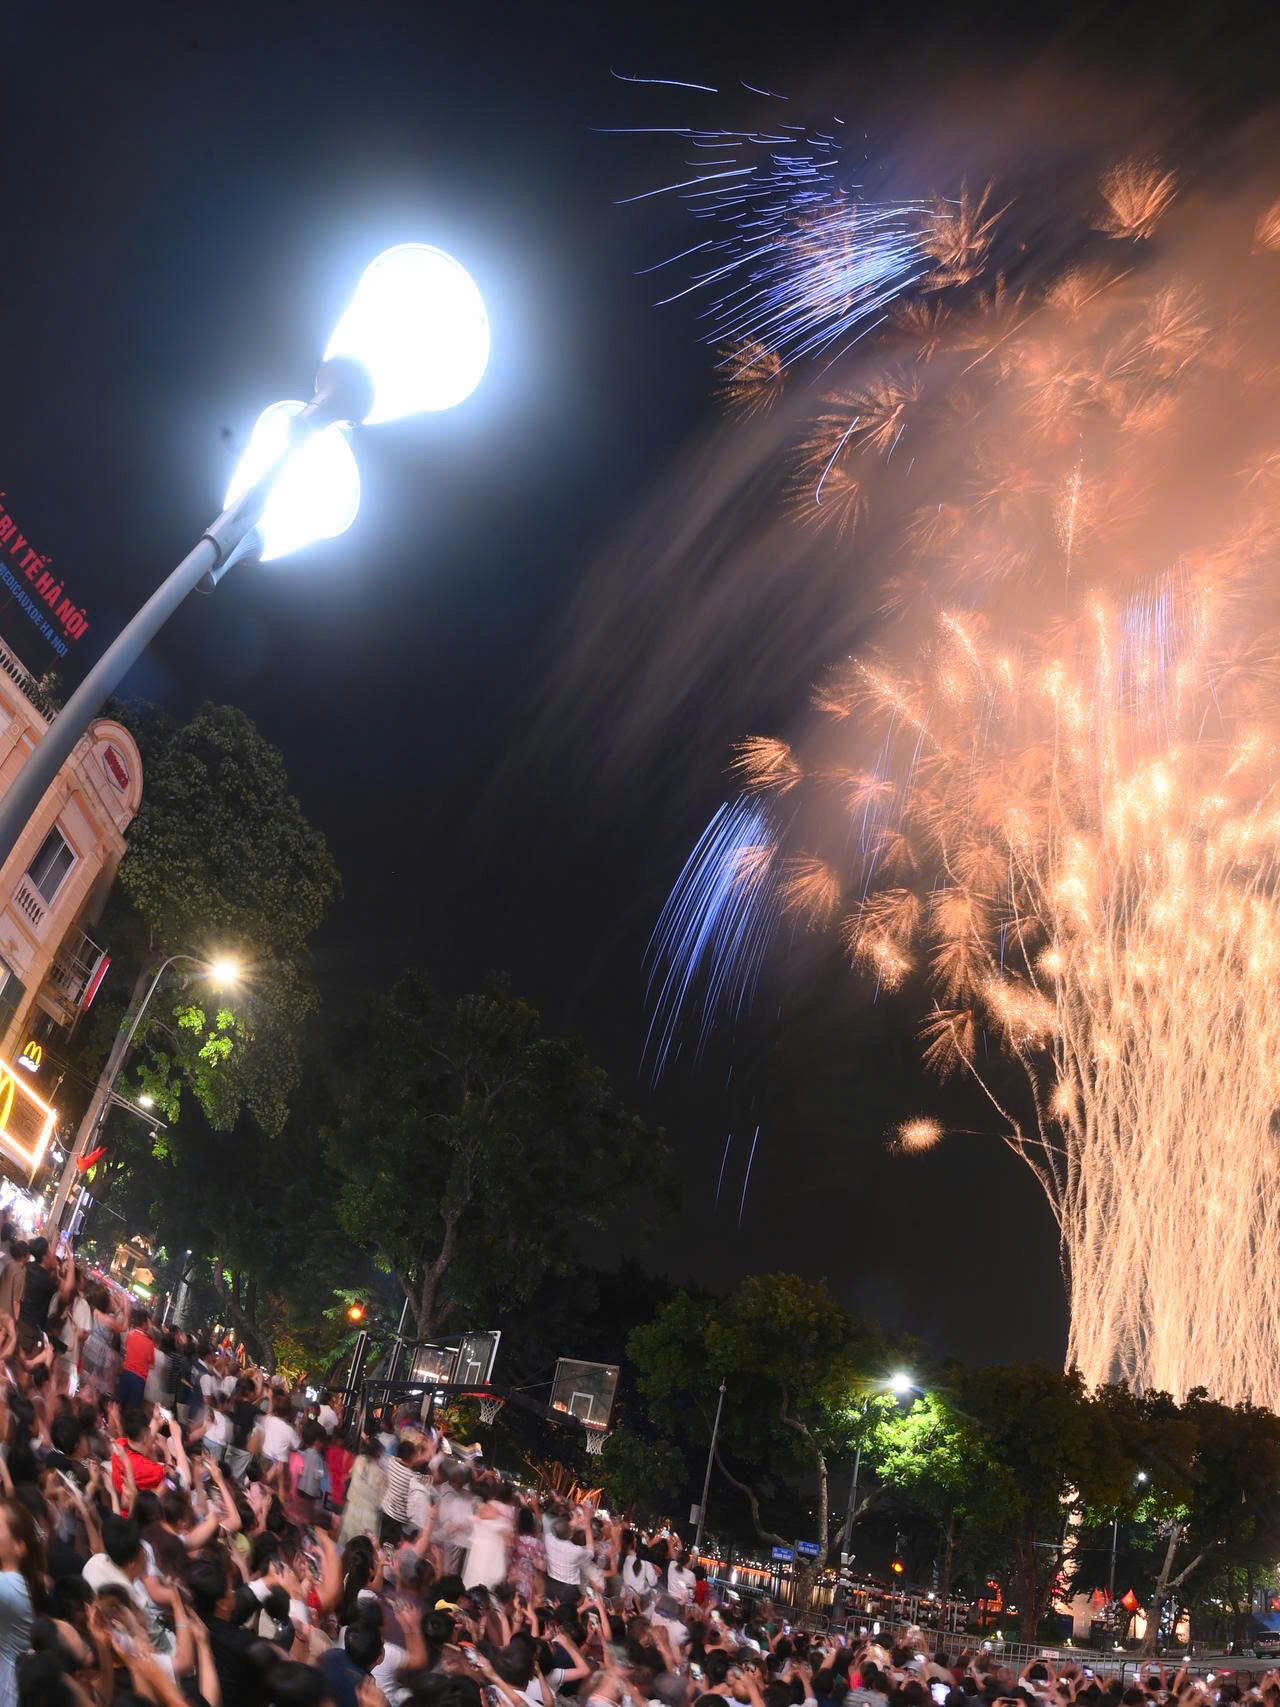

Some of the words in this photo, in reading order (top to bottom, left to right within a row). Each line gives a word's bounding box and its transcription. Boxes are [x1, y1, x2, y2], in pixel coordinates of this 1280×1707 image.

[9, 534, 28, 554] Y
[19, 548, 52, 581] TẾ
[35, 570, 65, 609] HÀ
[55, 597, 89, 640] NỘI
